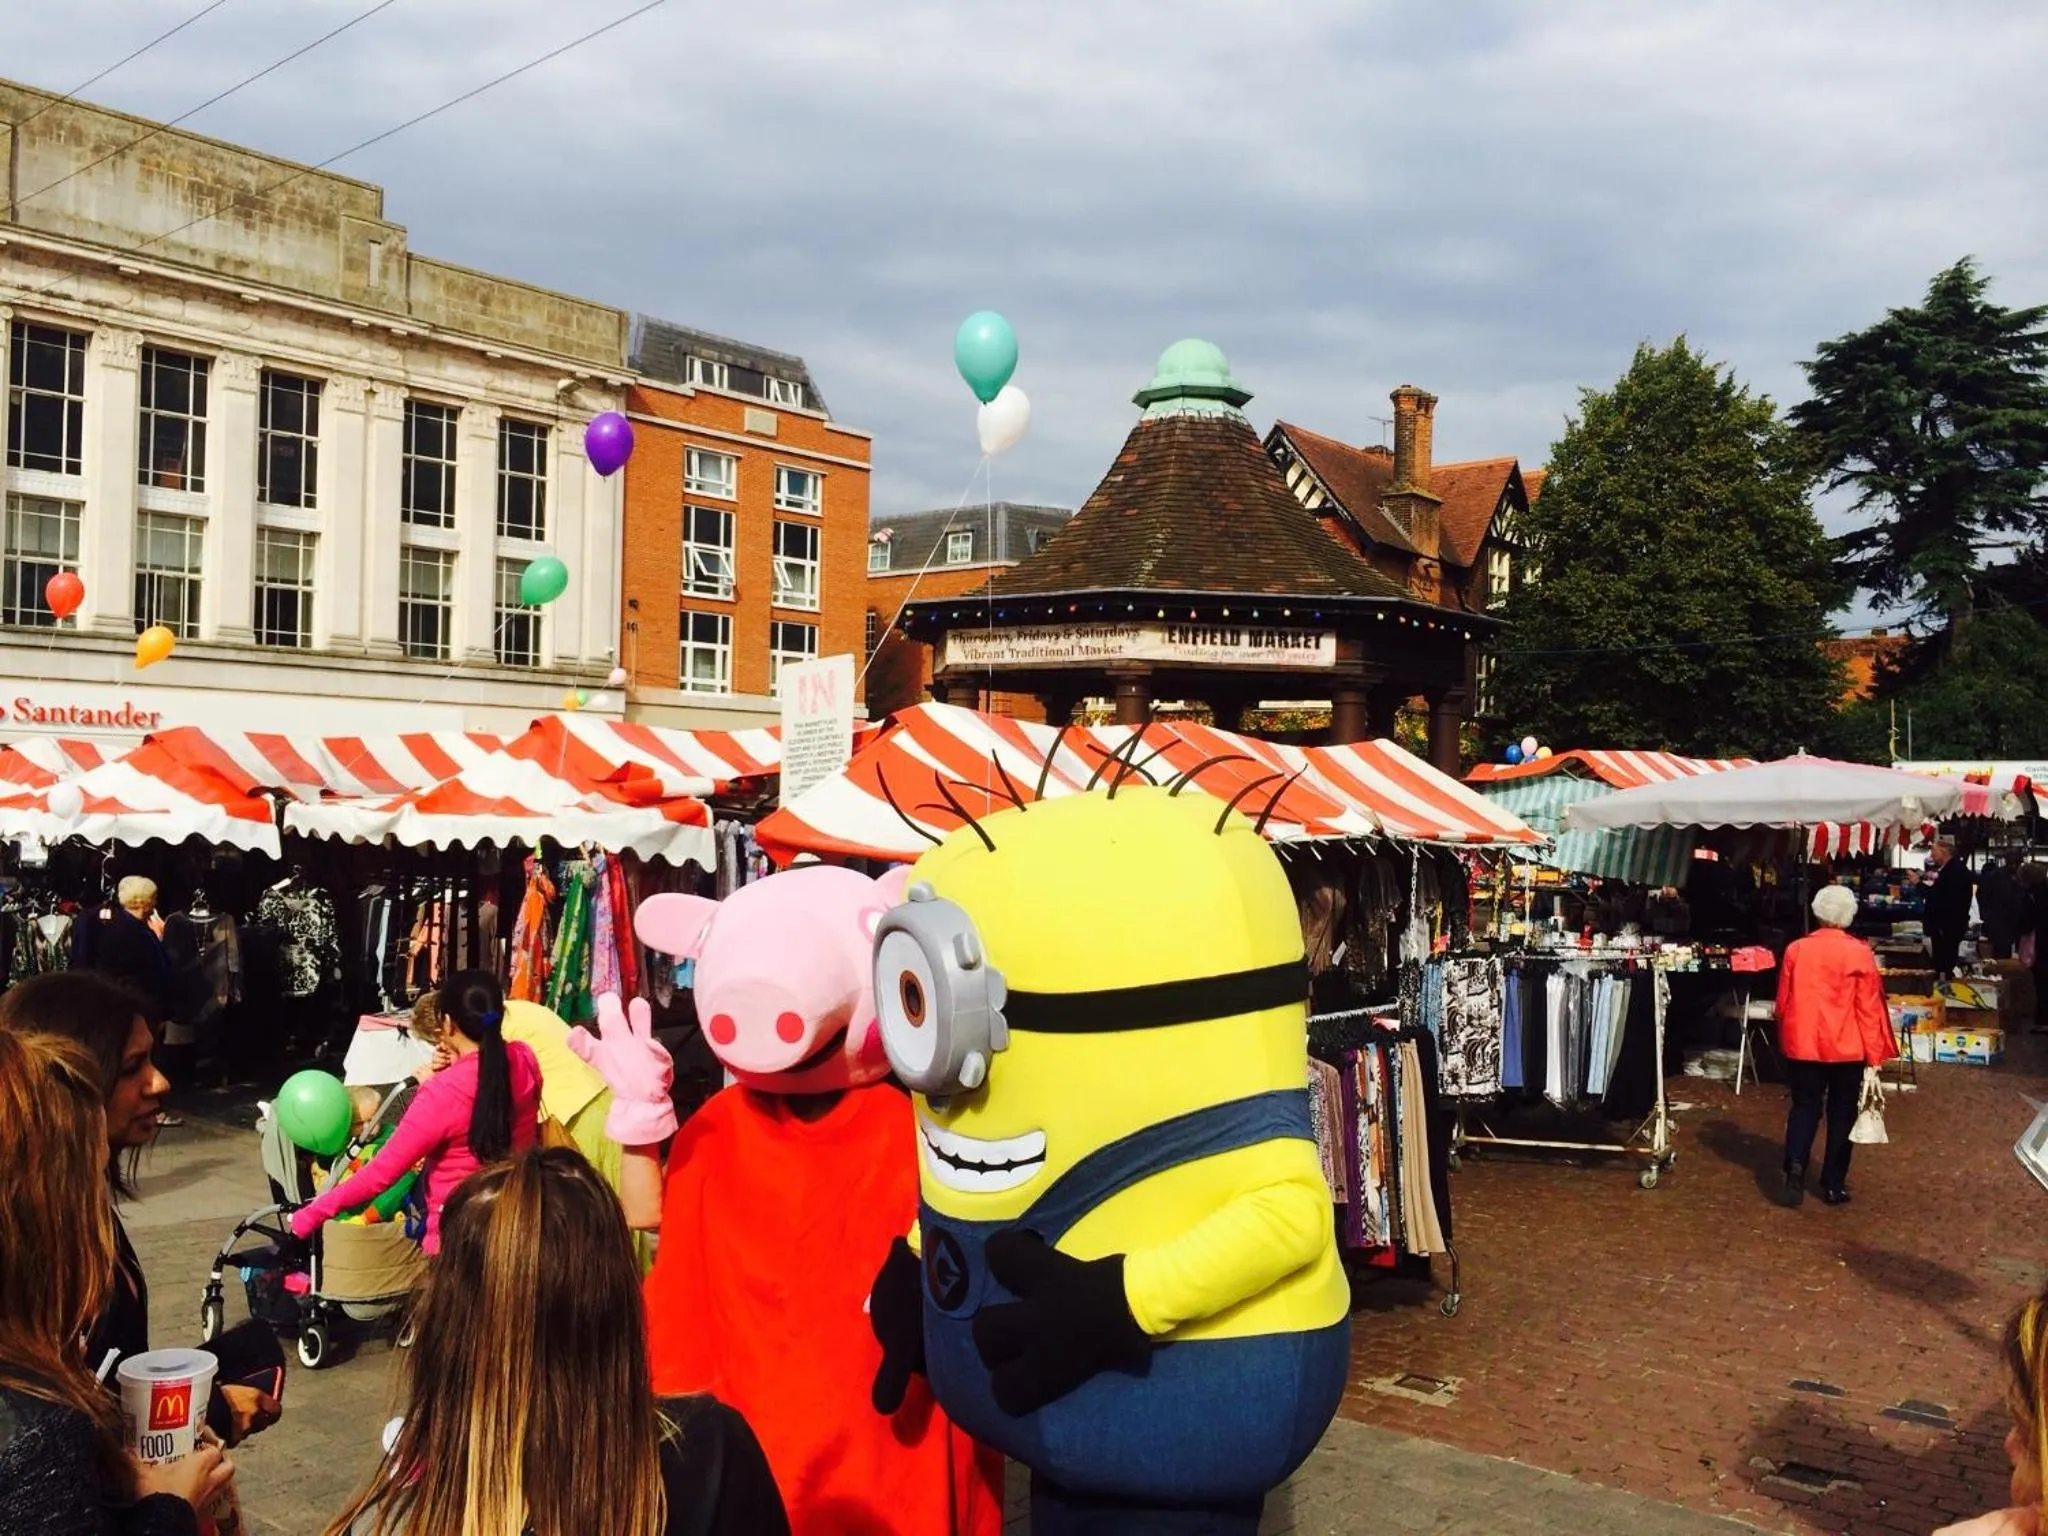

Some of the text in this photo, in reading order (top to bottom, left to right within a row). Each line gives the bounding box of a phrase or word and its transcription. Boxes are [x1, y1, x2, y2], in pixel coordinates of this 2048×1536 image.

[951, 626, 1141, 644] Thursdays, Fridays & Saturdays
[1167, 626, 1323, 649] ENFIELD MARKET
[963, 644, 1123, 660] Vibrant Traditional Market
[797, 668, 837, 716] IN
[13, 697, 163, 727] Santander
[140, 1432, 173, 1458] FOOD
